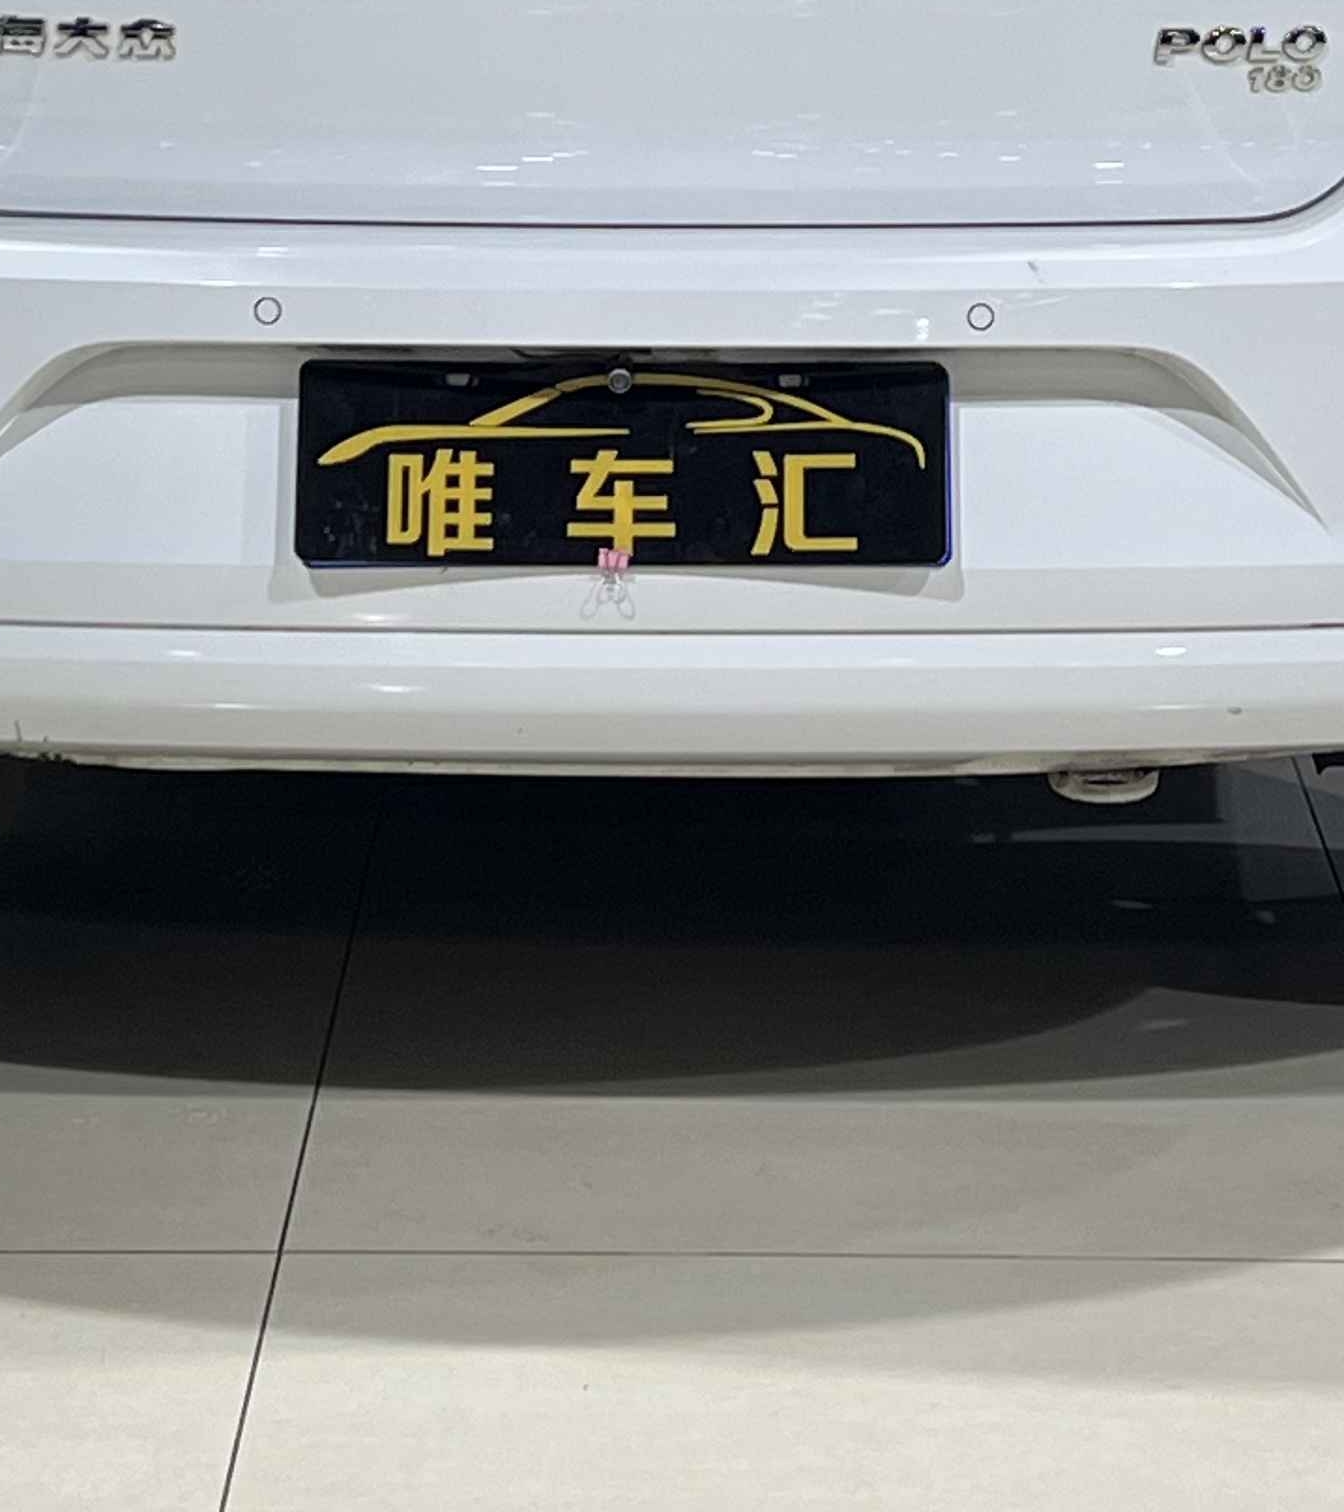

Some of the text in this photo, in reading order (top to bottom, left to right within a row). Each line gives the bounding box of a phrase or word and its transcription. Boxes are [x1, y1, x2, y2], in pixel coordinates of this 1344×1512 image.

[1153, 25, 1328, 65] POLO
[1247, 64, 1323, 93] 180
[386, 448, 858, 557] 唯车汇
